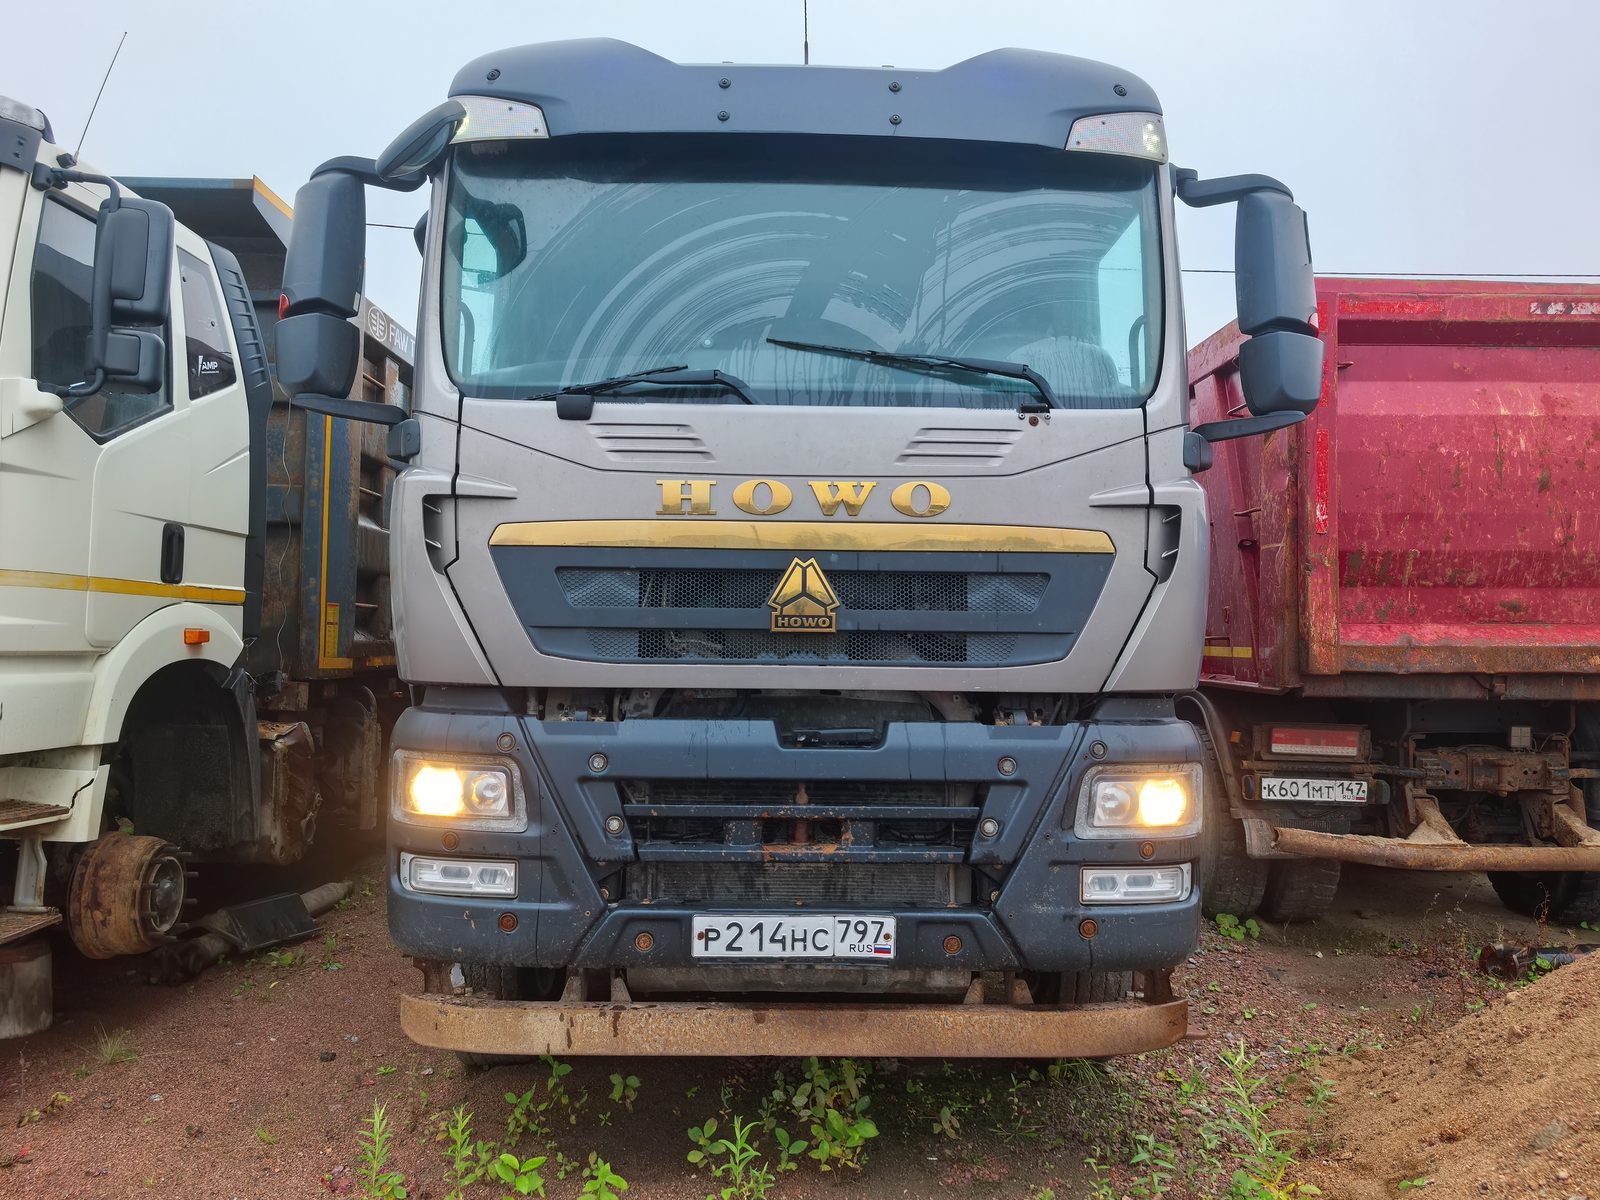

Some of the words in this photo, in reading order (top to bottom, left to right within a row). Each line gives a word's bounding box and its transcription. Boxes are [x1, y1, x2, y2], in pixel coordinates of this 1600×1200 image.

[389, 322, 409, 353] FAW
[655, 478, 951, 518] HOWO
[776, 615, 831, 628] HOWO
[1337, 781, 1364, 796] 147
[837, 919, 885, 944] 797
[849, 944, 873, 953] RUS
